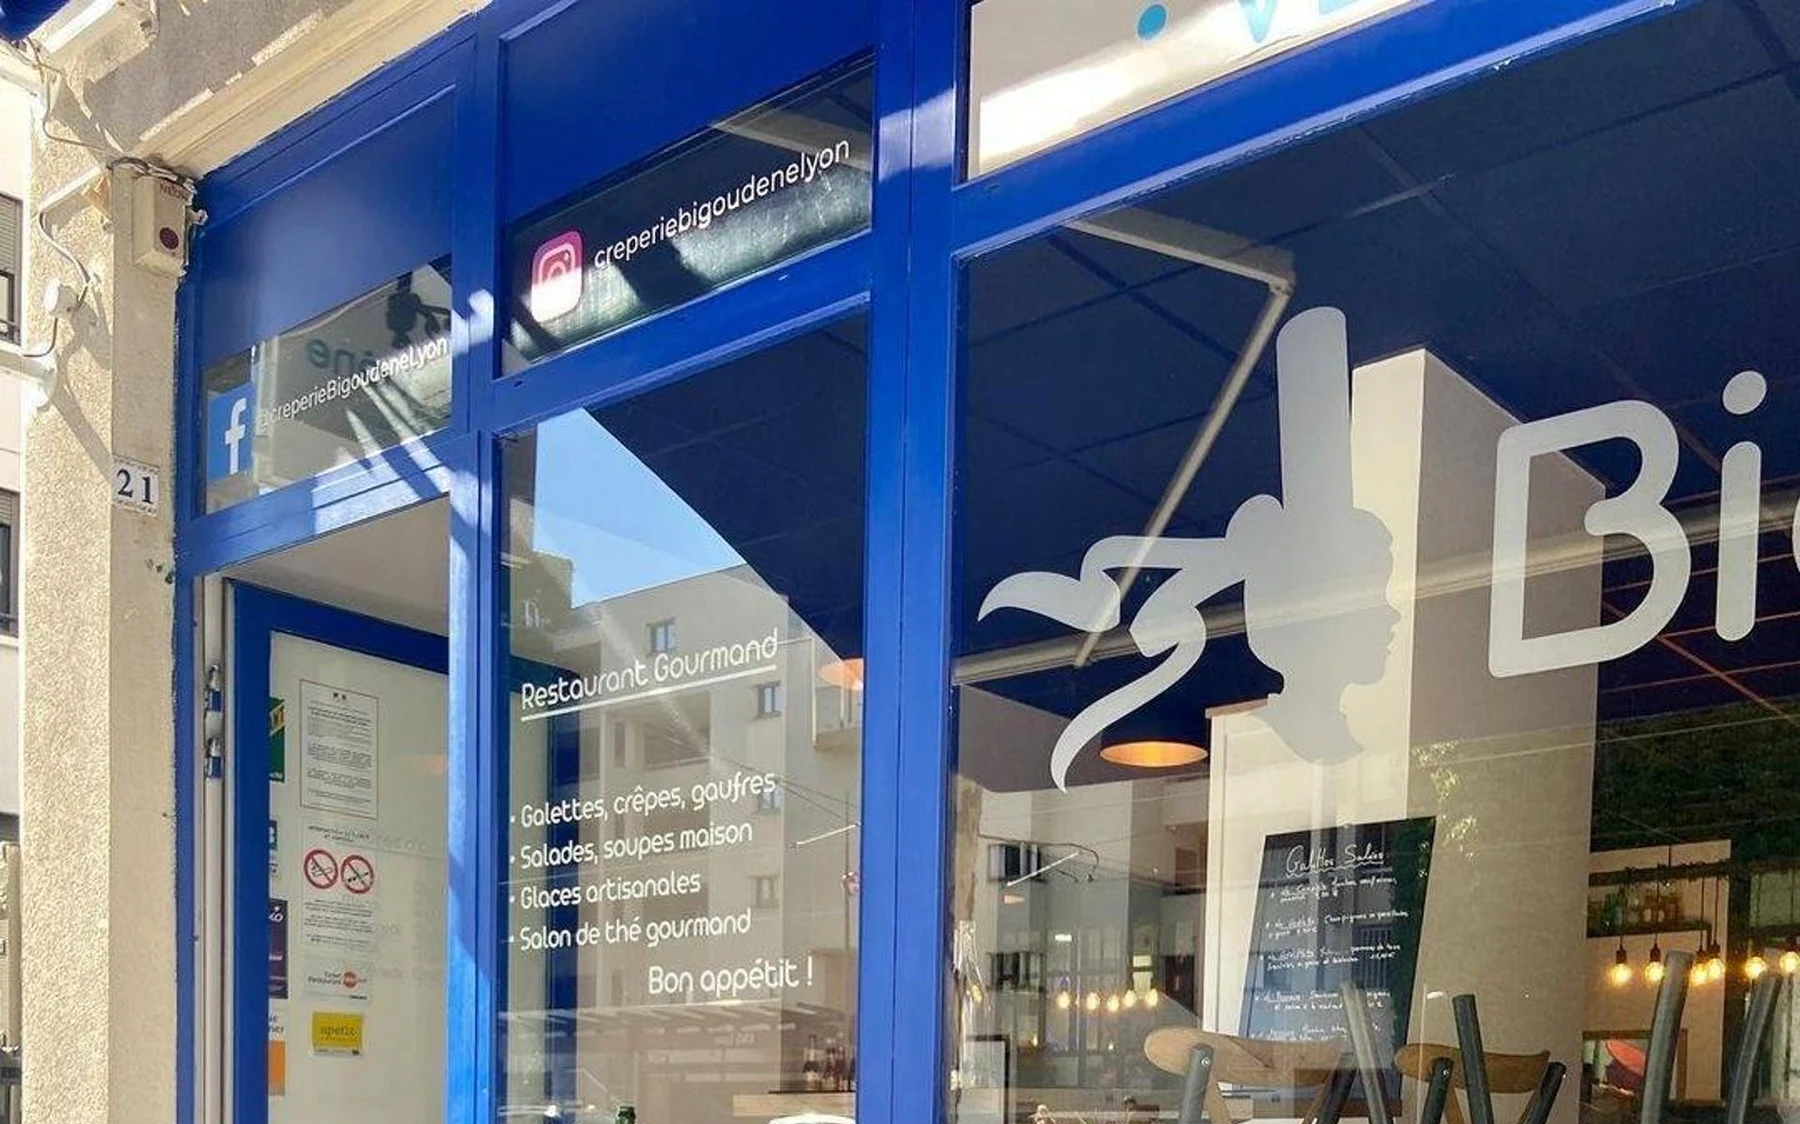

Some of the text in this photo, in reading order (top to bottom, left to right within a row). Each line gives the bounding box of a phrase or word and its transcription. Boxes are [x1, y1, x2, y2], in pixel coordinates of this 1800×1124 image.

[594, 139, 849, 269] creperiebigoudenelyon
[117, 468, 154, 504] 21
[1489, 370, 1800, 678] Bi
[521, 627, 778, 710] Restaurant Gourmand
[521, 771, 776, 828] Galettes, crêpes, gaufres
[521, 821, 753, 869] Salades, soupes maison
[521, 870, 701, 909] Glaces artisanales
[520, 908, 751, 951] Salon de thé gourmand
[649, 965, 693, 995] Bon
[700, 957, 799, 998] appétit
